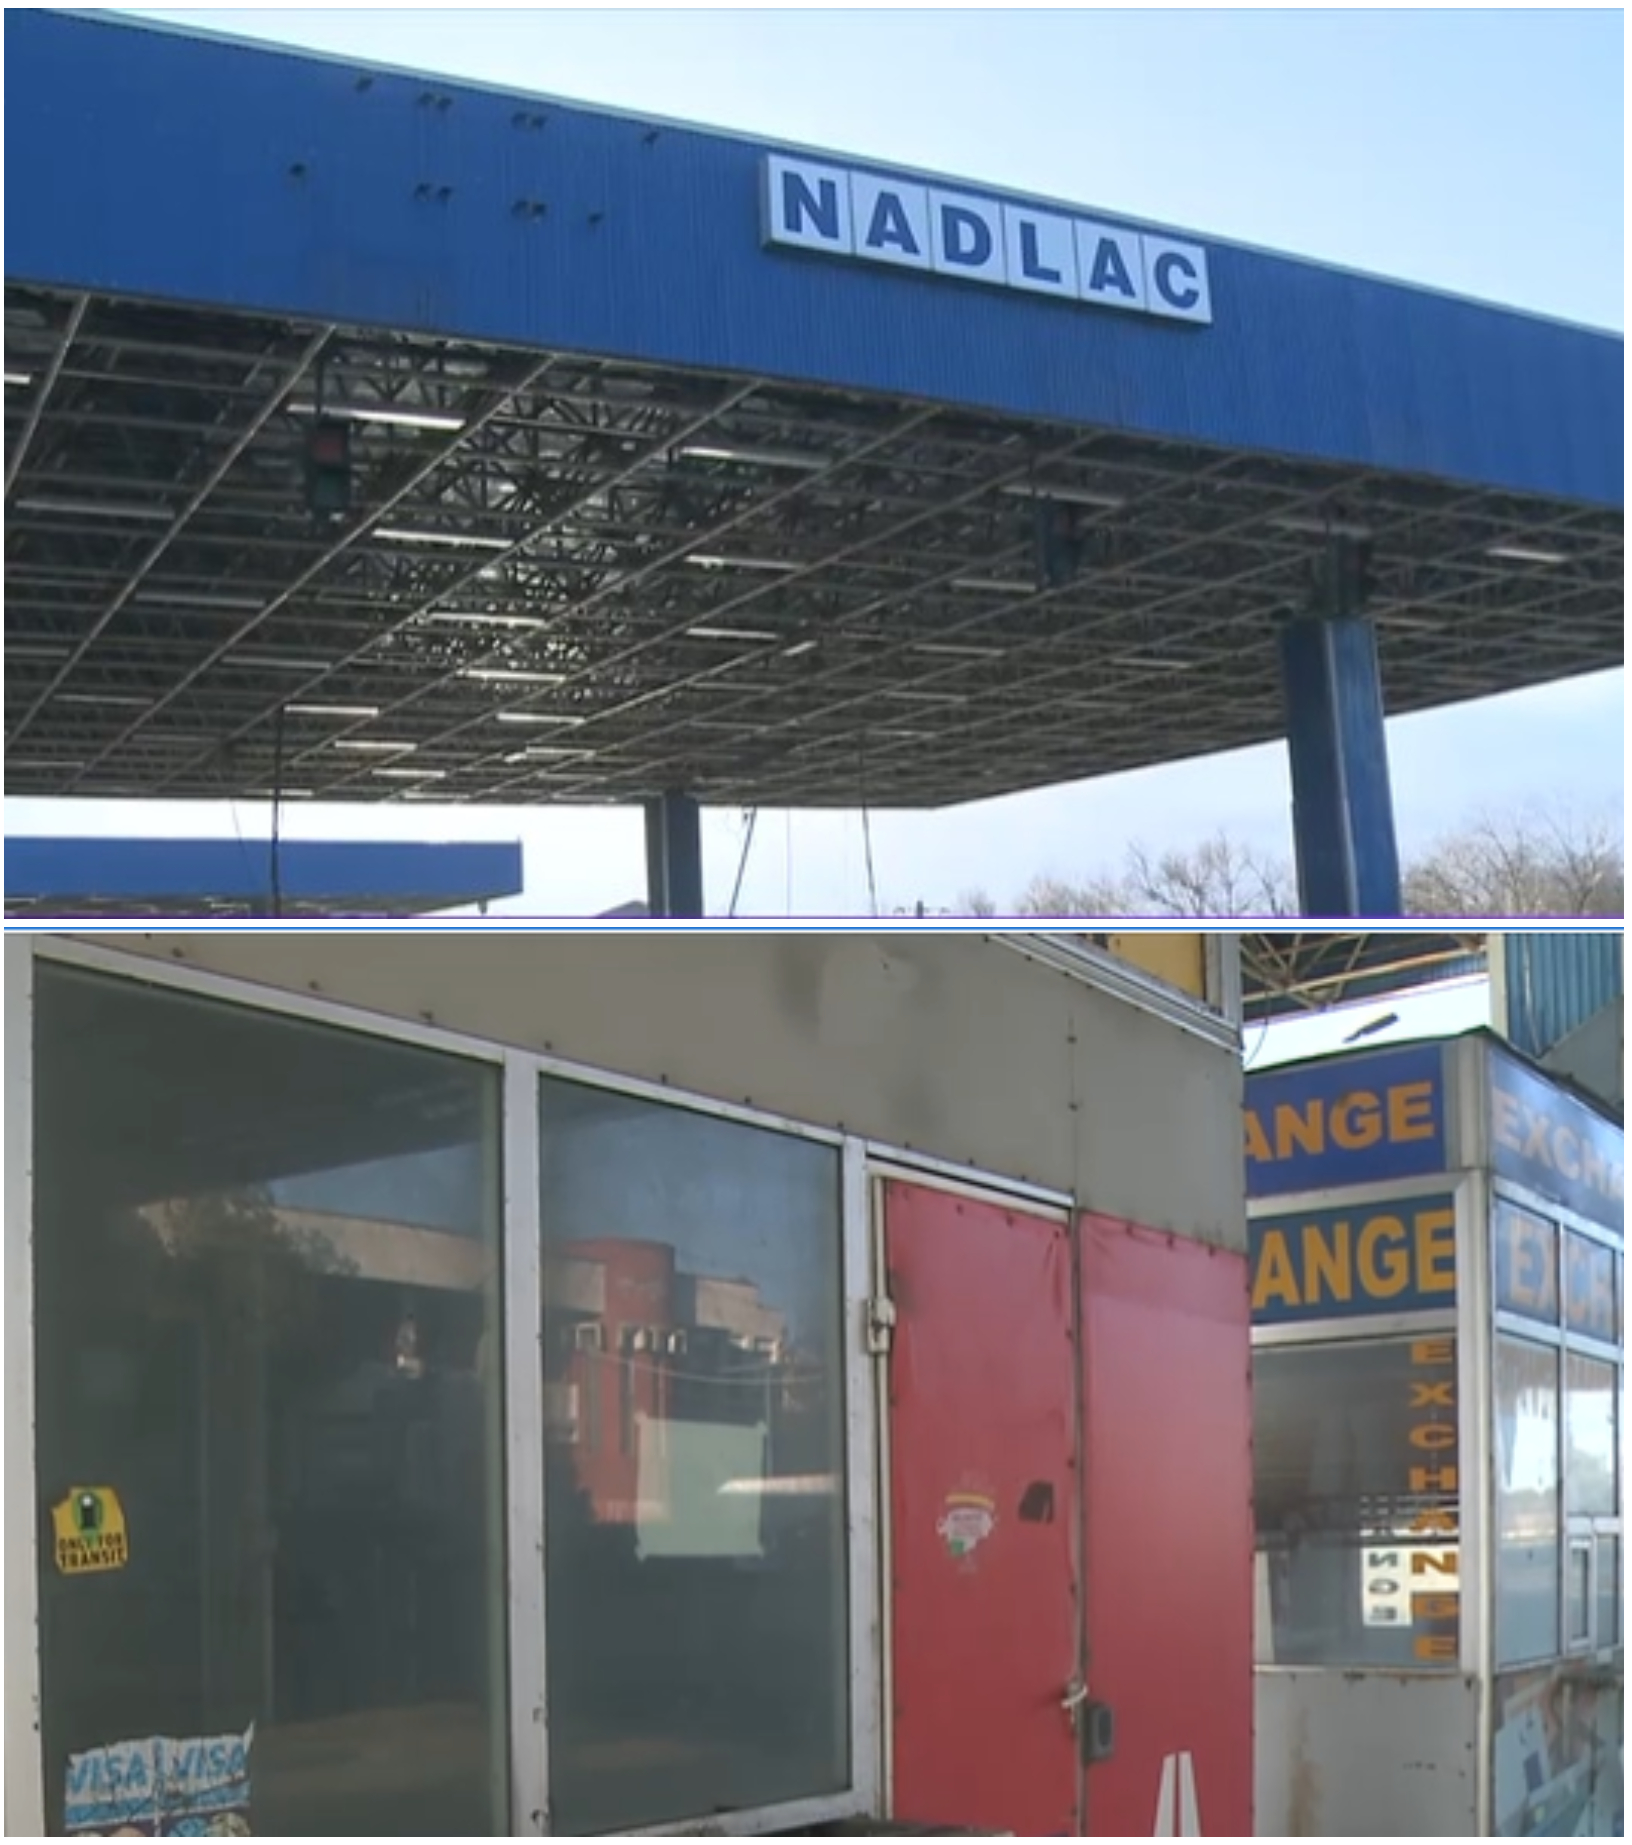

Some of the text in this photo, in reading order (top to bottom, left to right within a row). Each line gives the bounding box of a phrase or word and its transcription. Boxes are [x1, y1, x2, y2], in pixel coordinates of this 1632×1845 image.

[782, 171, 1200, 308] NADLAC
[98, 1532, 122, 1548] FOR
[60, 1548, 124, 1568] TRANSIT
[70, 1742, 245, 1793] VISA VISA
